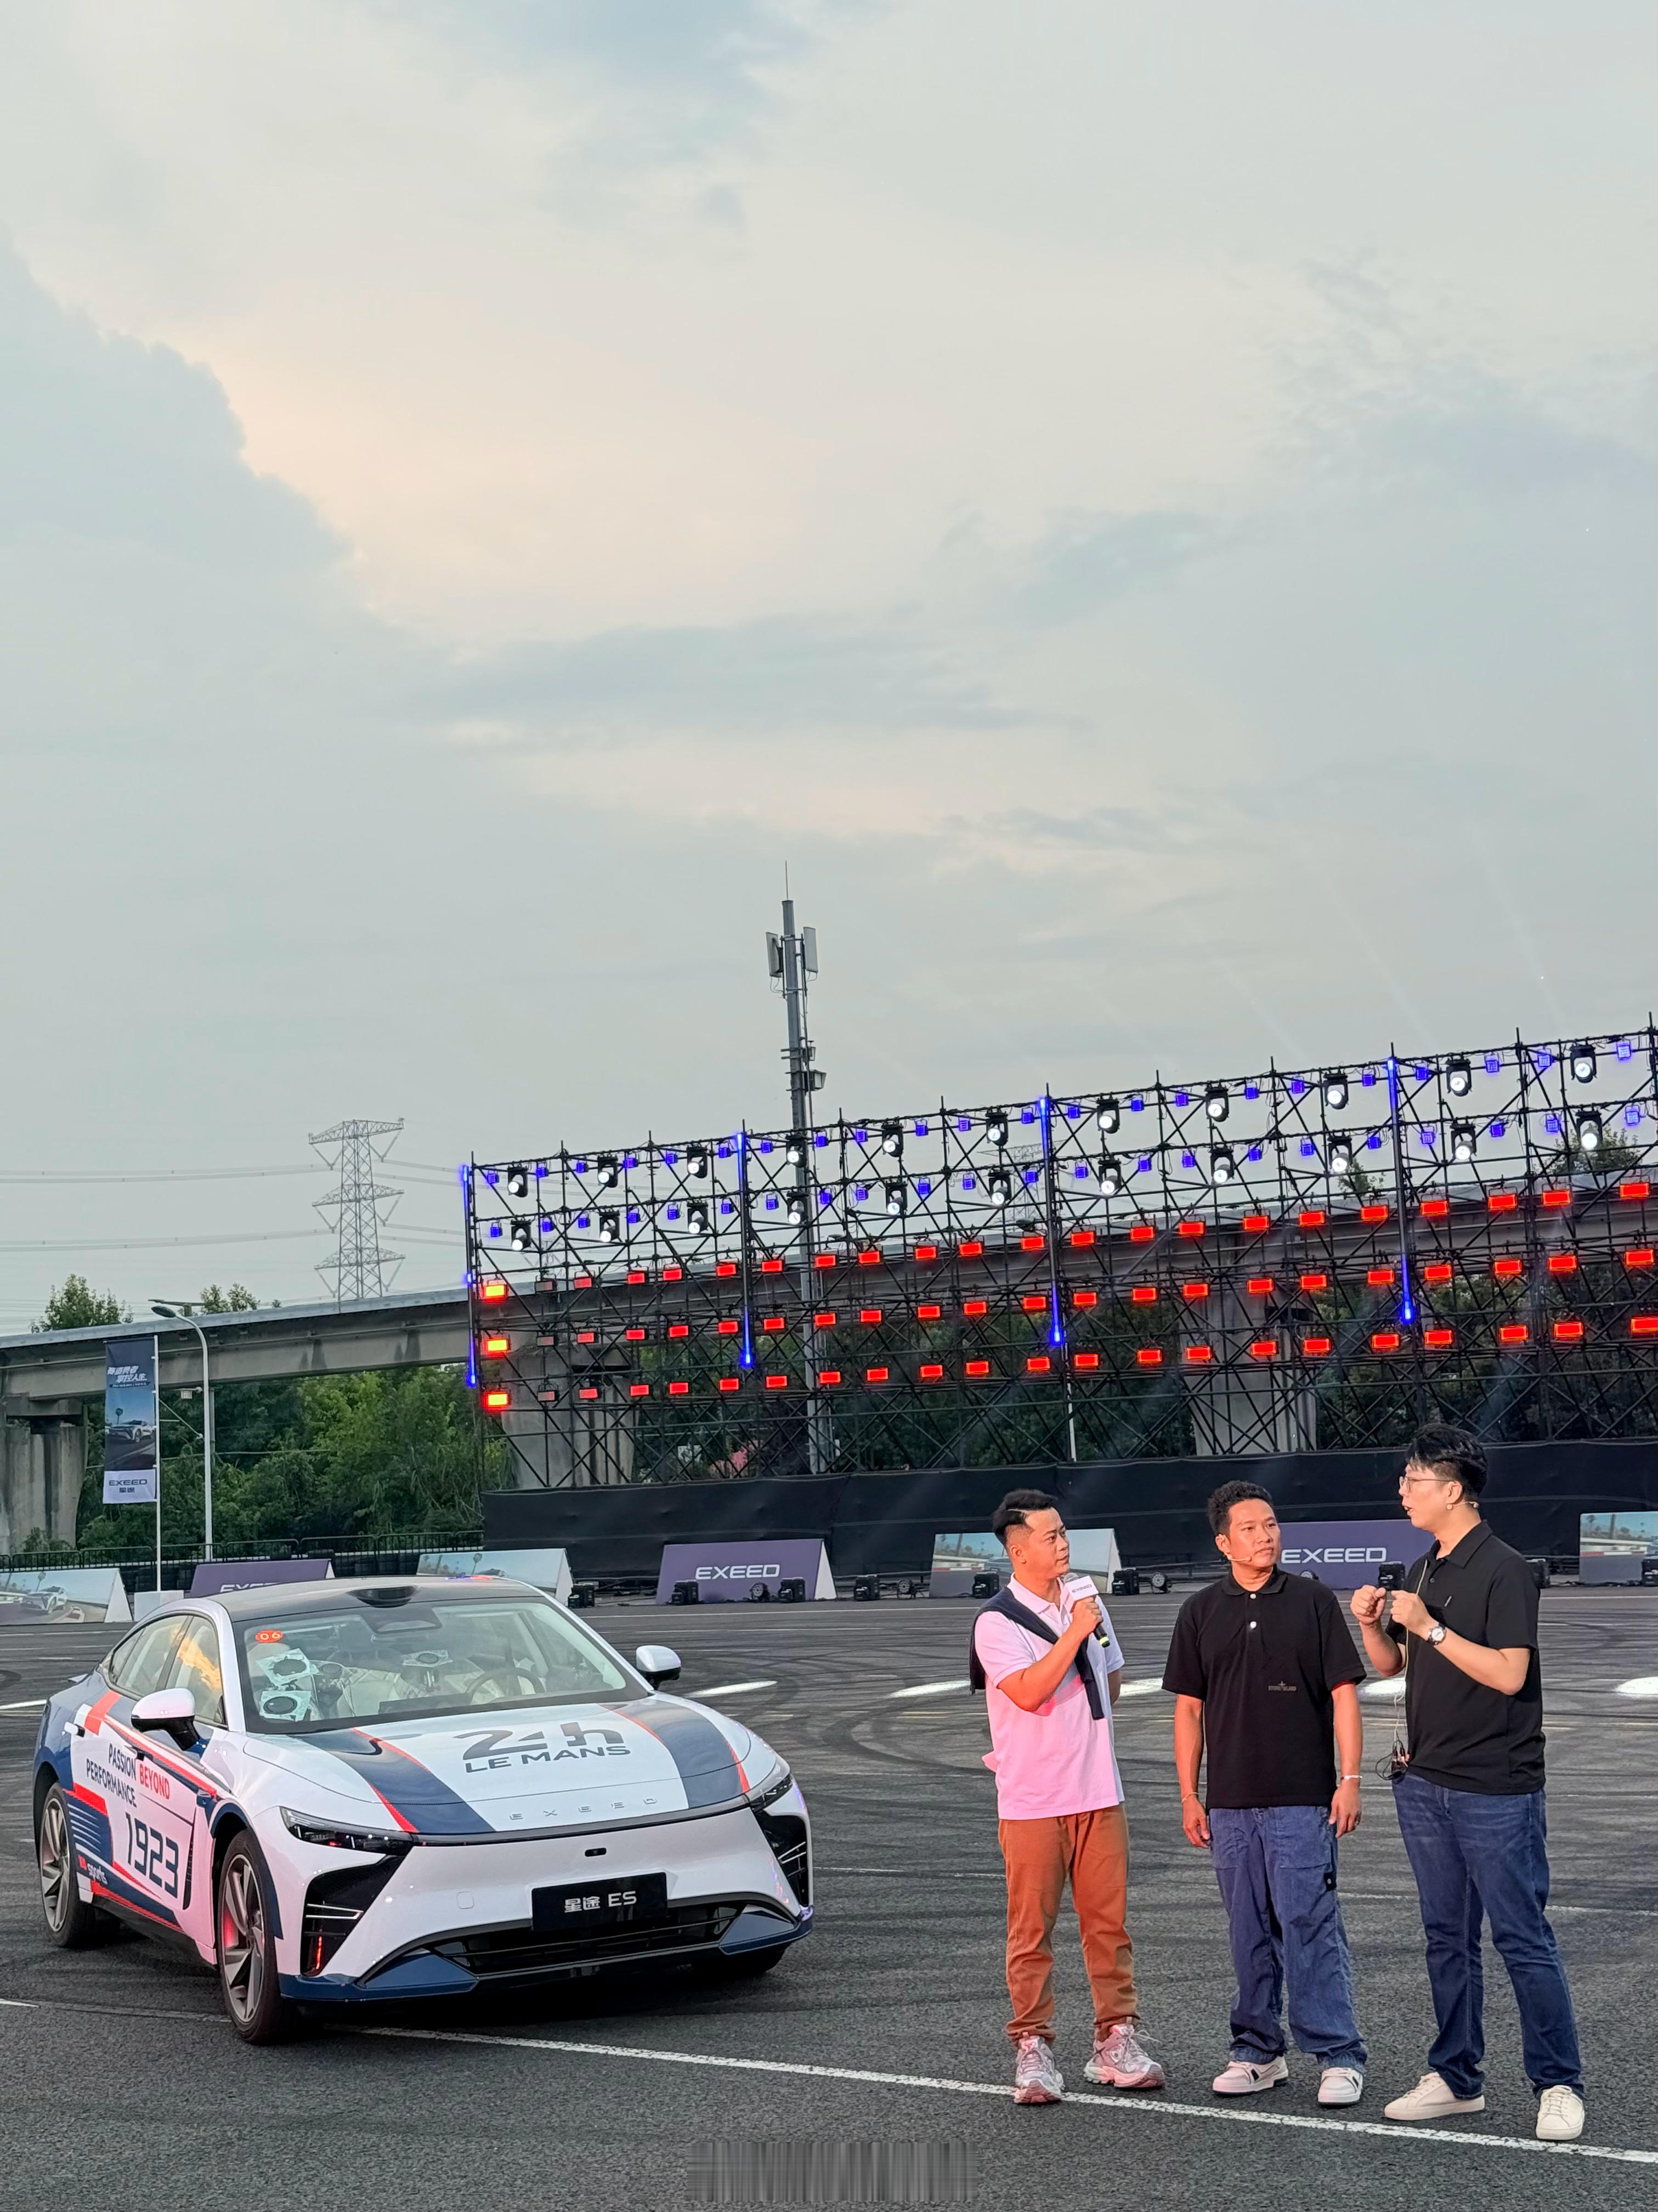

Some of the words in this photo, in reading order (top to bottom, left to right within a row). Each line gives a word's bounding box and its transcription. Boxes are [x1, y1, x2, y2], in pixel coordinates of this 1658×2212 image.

[1281, 1547, 1387, 1564] EXEED
[695, 1564, 780, 1580] EXEED
[260, 1632, 281, 1640] 06
[465, 1756, 512, 1773] LE
[520, 1746, 631, 1765] MANS
[86, 1758, 137, 1808] PERFORMANCE
[108, 1743, 137, 1781] PASSION
[139, 1763, 170, 1800] BEYOND
[510, 1797, 658, 1820] EXEED
[125, 1812, 179, 1899] 1923
[564, 1896, 601, 1913] 星途
[608, 1891, 637, 1908] ES
